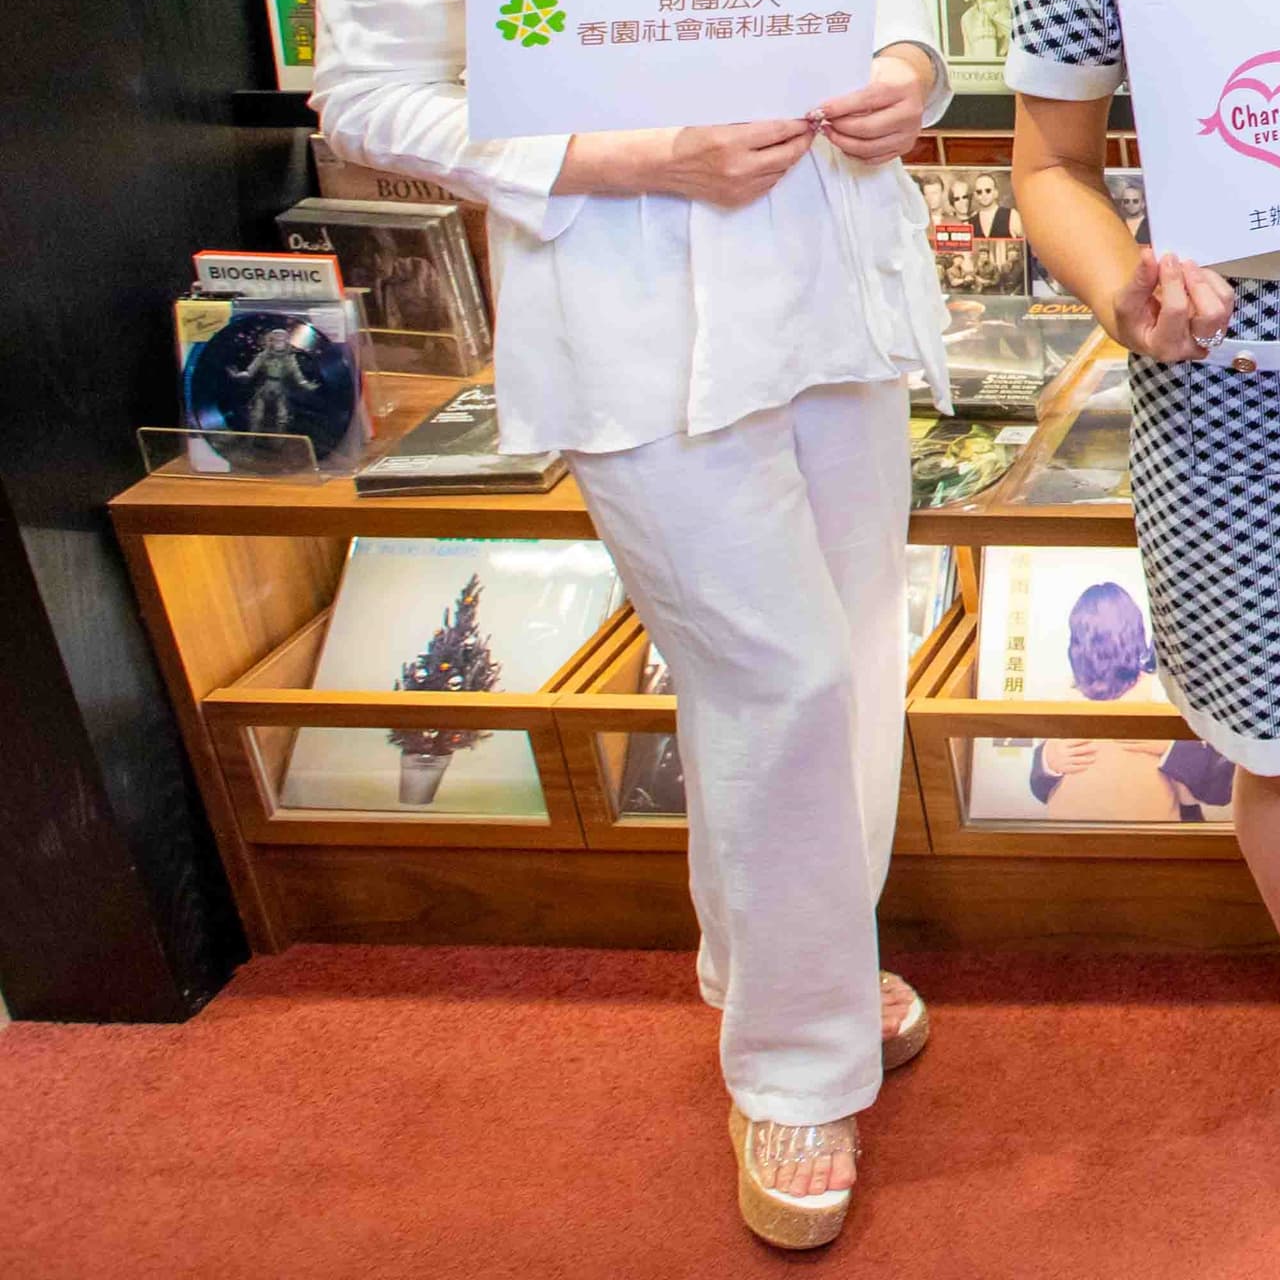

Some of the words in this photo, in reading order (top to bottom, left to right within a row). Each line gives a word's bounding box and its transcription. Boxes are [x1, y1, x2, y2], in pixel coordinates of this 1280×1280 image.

[576, 10, 853, 47] 香園社會福利基金會
[377, 177, 455, 201] BOWI
[208, 265, 323, 284] BIOGRAPHIC
[1028, 303, 1092, 314] BOWI
